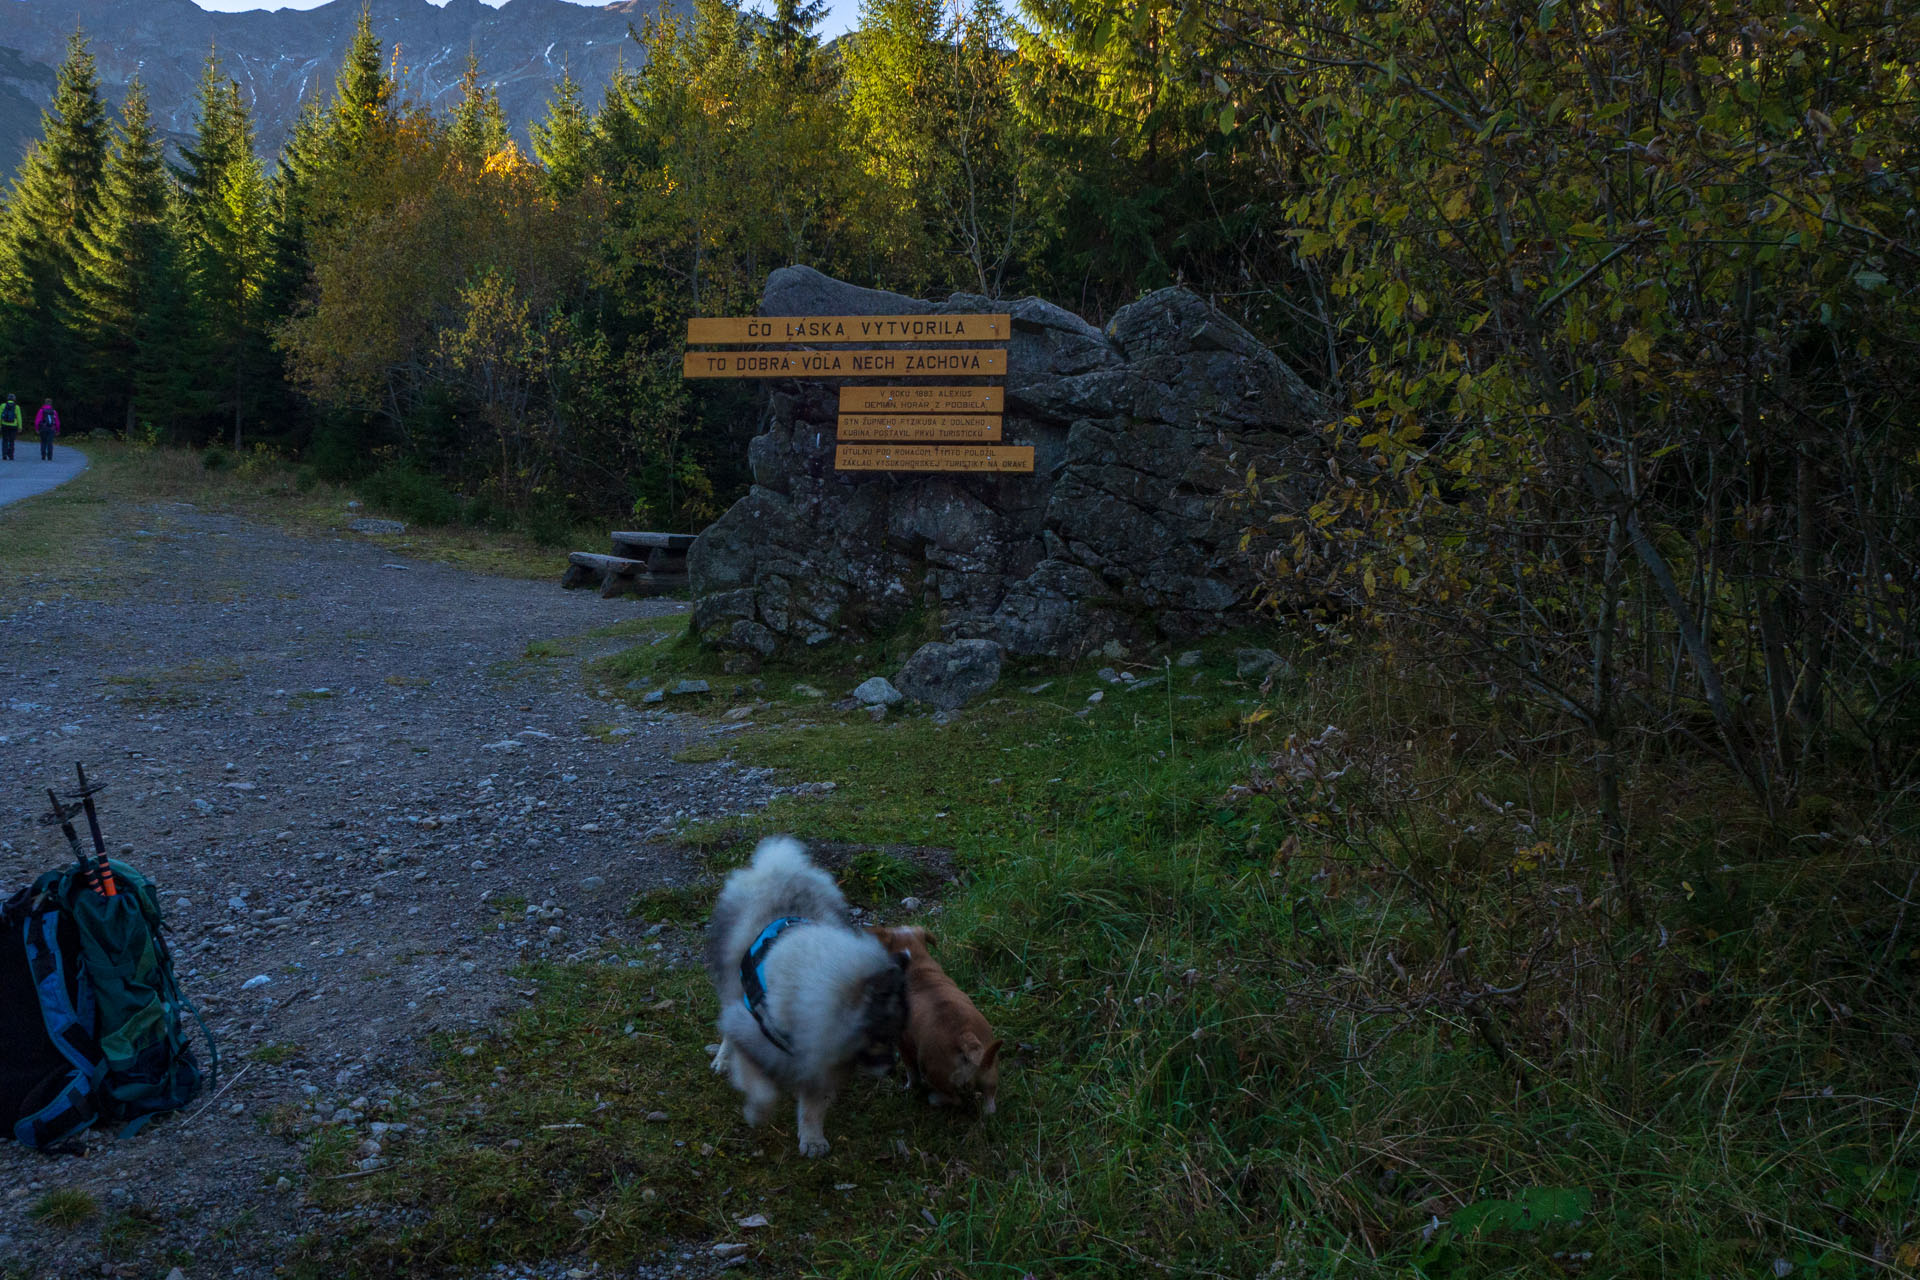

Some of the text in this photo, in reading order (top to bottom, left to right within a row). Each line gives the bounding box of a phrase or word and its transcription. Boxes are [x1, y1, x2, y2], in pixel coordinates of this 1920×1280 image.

[748, 318, 965, 336] ČO LÁSKA VYTVORILA
[707, 351, 980, 371] TO DOBRÁ VÔĽA NECH ZACHOVÁ
